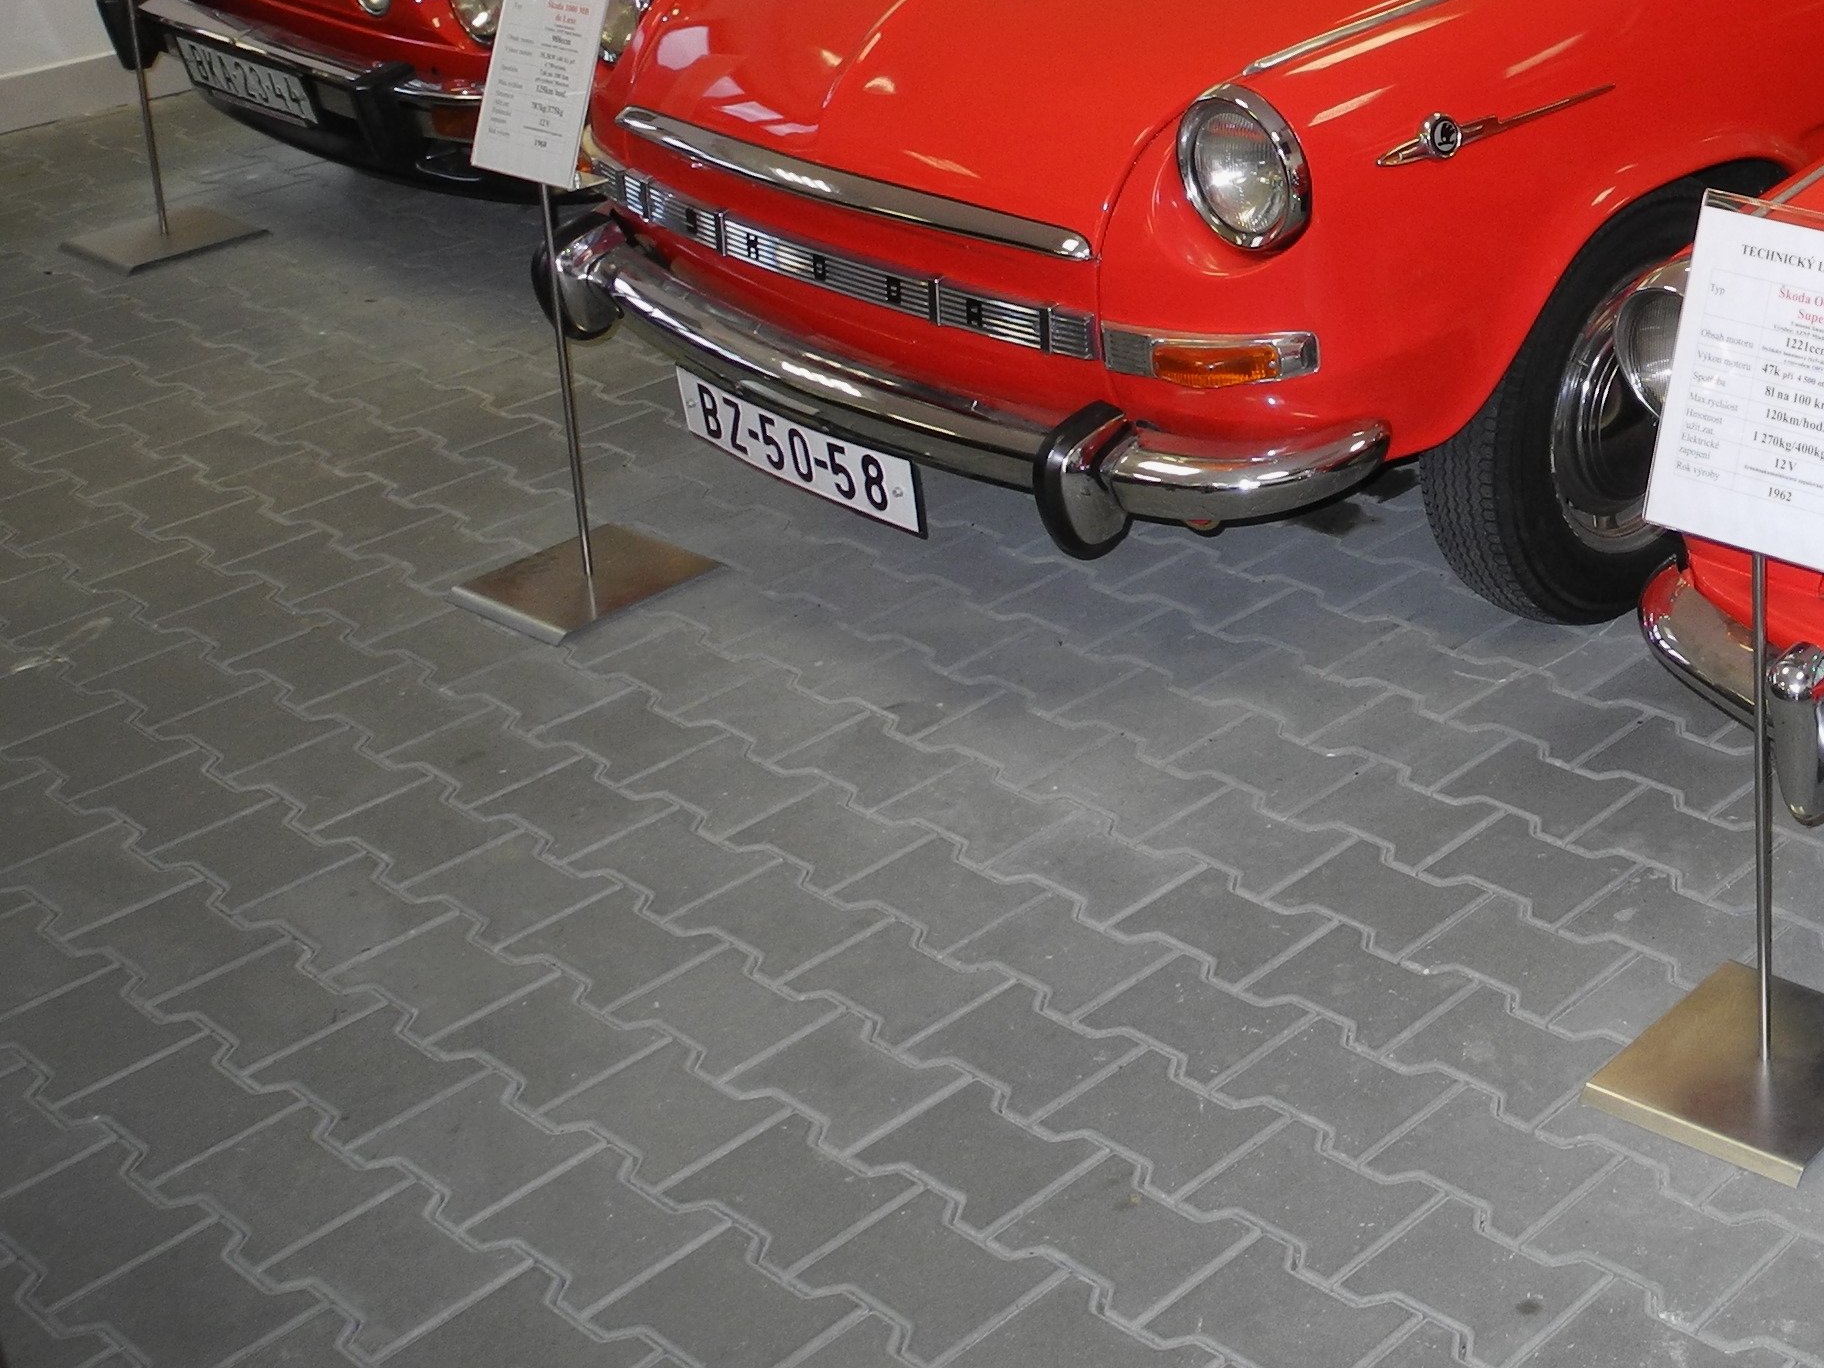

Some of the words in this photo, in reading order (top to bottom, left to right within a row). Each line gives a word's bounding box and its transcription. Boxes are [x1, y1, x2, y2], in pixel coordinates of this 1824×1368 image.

[1740, 242, 1814, 270] TECHNICKÝ
[1709, 283, 1725, 297] Typ
[1778, 285, 1811, 305] Škoda
[1692, 369, 1726, 388] Spotřba
[1776, 390, 1789, 401] na
[1792, 392, 1811, 406] 100
[697, 382, 889, 511] BZ-50-58
[1676, 461, 1691, 472] Rok
[1768, 486, 1792, 502] 1962
